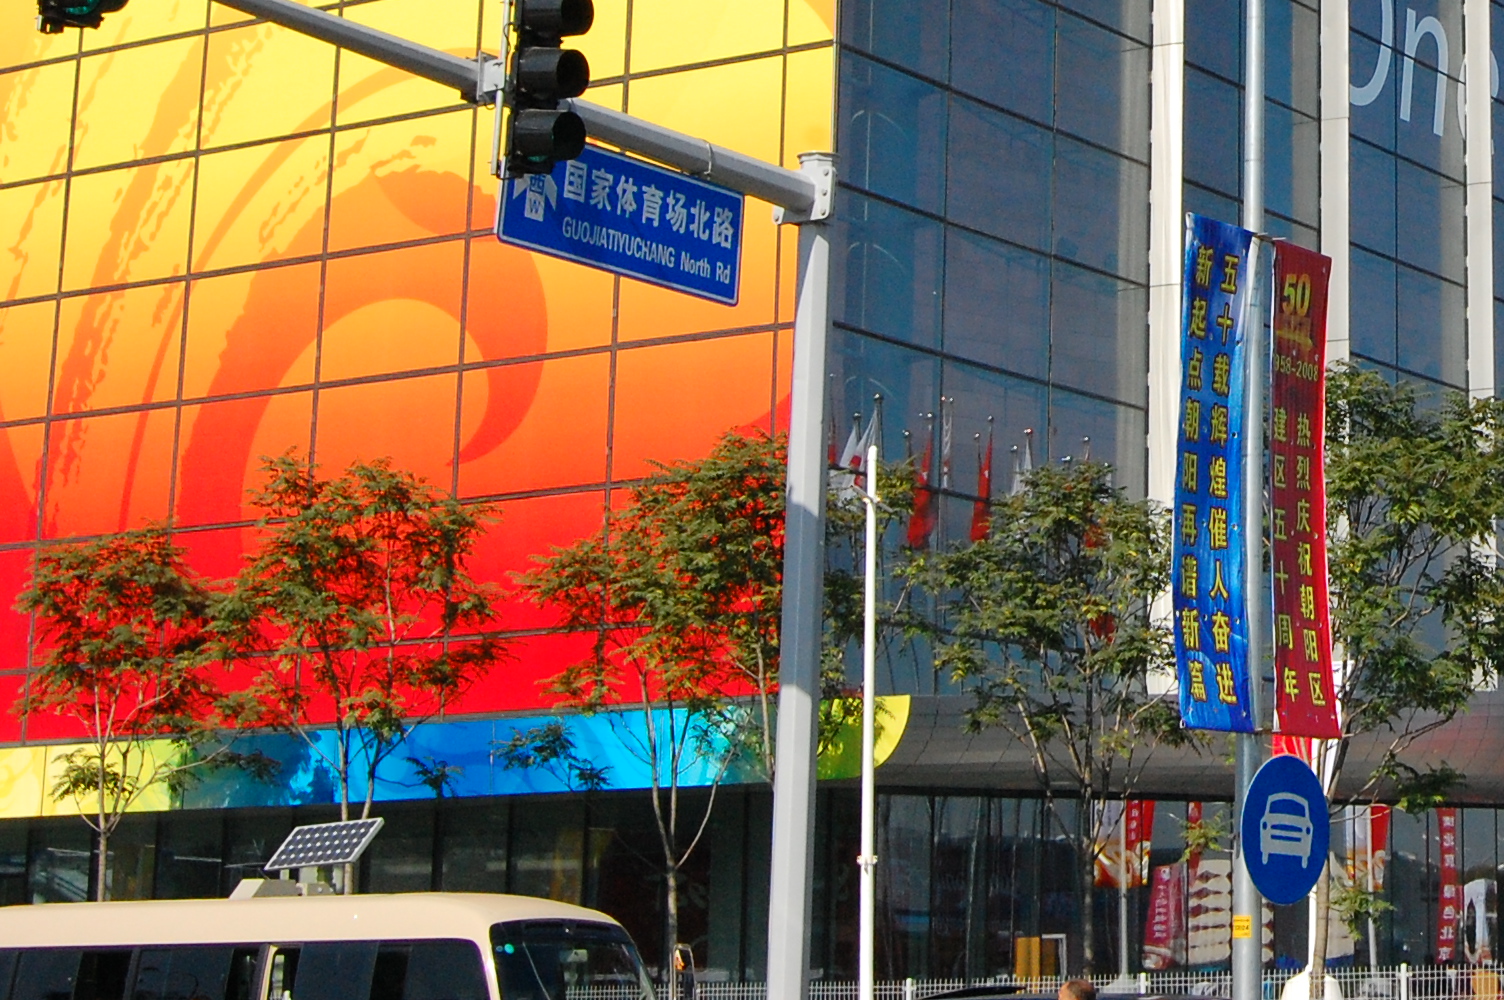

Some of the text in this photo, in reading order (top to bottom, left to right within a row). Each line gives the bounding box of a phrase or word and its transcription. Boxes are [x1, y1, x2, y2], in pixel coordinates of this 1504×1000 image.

[529, 198, 541, 214] W
[563, 160, 735, 249] 国家体育场北路
[562, 217, 731, 285] GUOJIATIYUCHANG North Rd
[1281, 273, 1311, 316] 50
[1274, 353, 1319, 382] 958-2008
[1208, 254, 1240, 705] 五十载辉煌催人奋进
[1273, 406, 1300, 702] 建区五十周年
[1296, 412, 1327, 706] 热烈庆祝朝阳区
